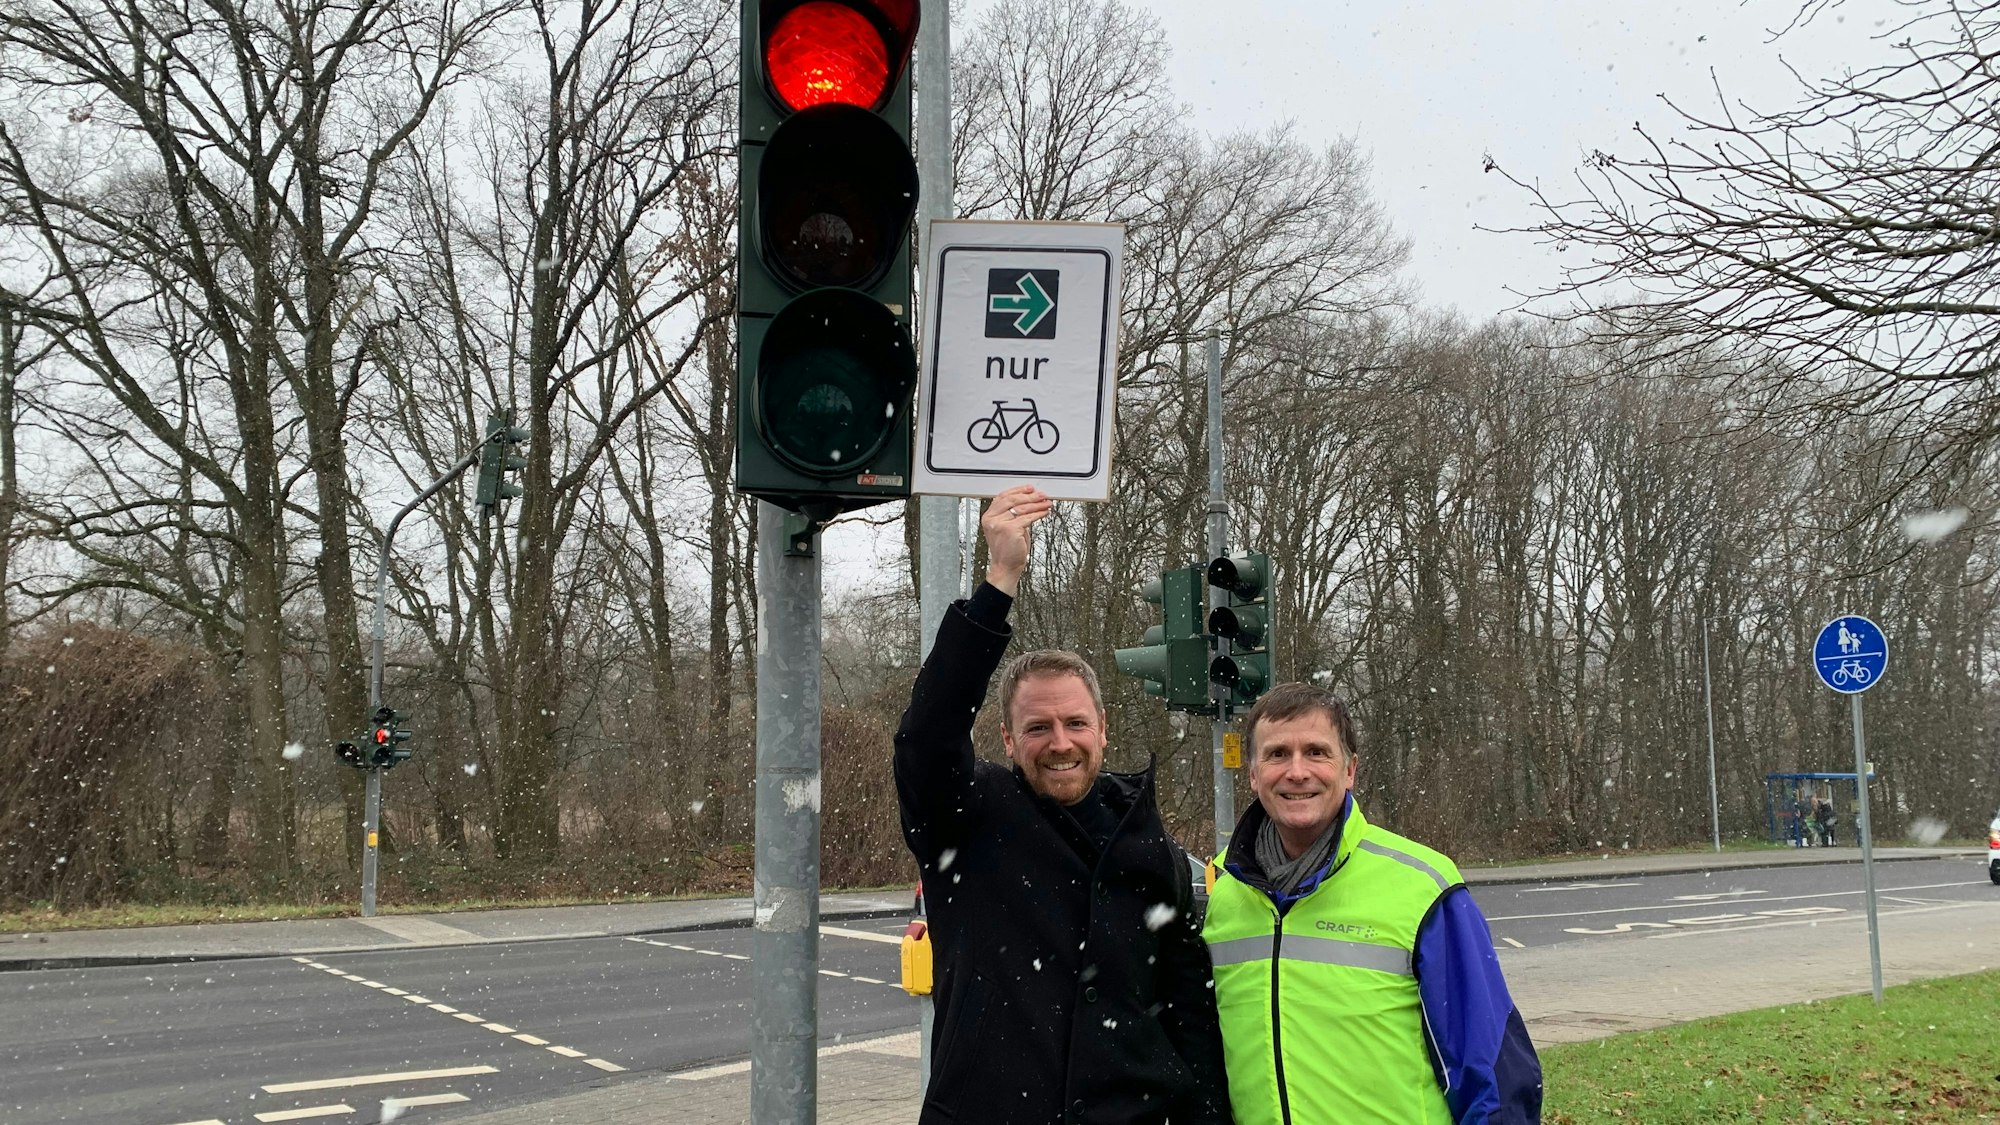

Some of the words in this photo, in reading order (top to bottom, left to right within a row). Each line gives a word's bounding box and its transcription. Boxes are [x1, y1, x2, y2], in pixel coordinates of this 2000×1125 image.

[986, 356, 1049, 380] nur
[1315, 920, 1365, 935] CRAFT
[1562, 906, 1847, 935] BUS
